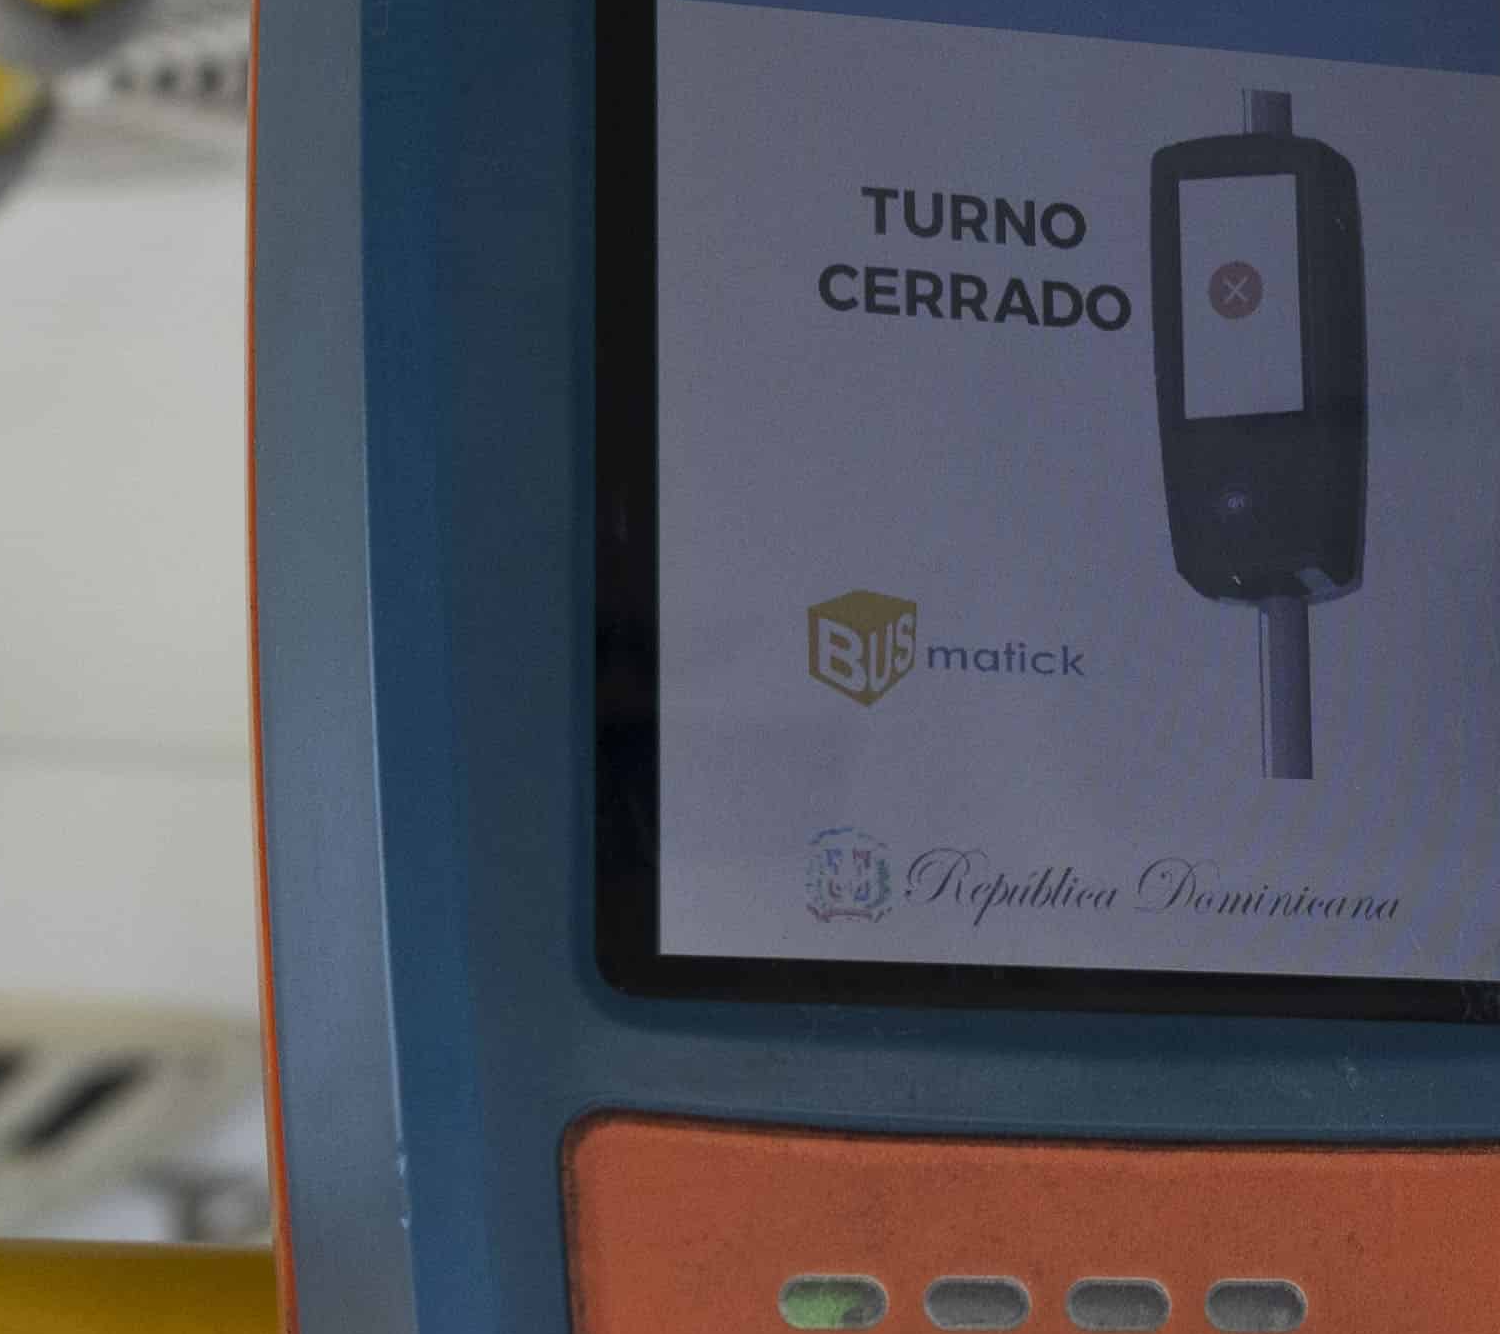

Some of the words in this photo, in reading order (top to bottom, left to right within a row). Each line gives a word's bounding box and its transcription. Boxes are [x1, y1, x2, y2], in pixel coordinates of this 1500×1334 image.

[860, 185, 1088, 250] TURNO
[818, 262, 1133, 332] CERRADO
[901, 846, 1119, 926] República
[1132, 857, 1402, 922] Dominicana
